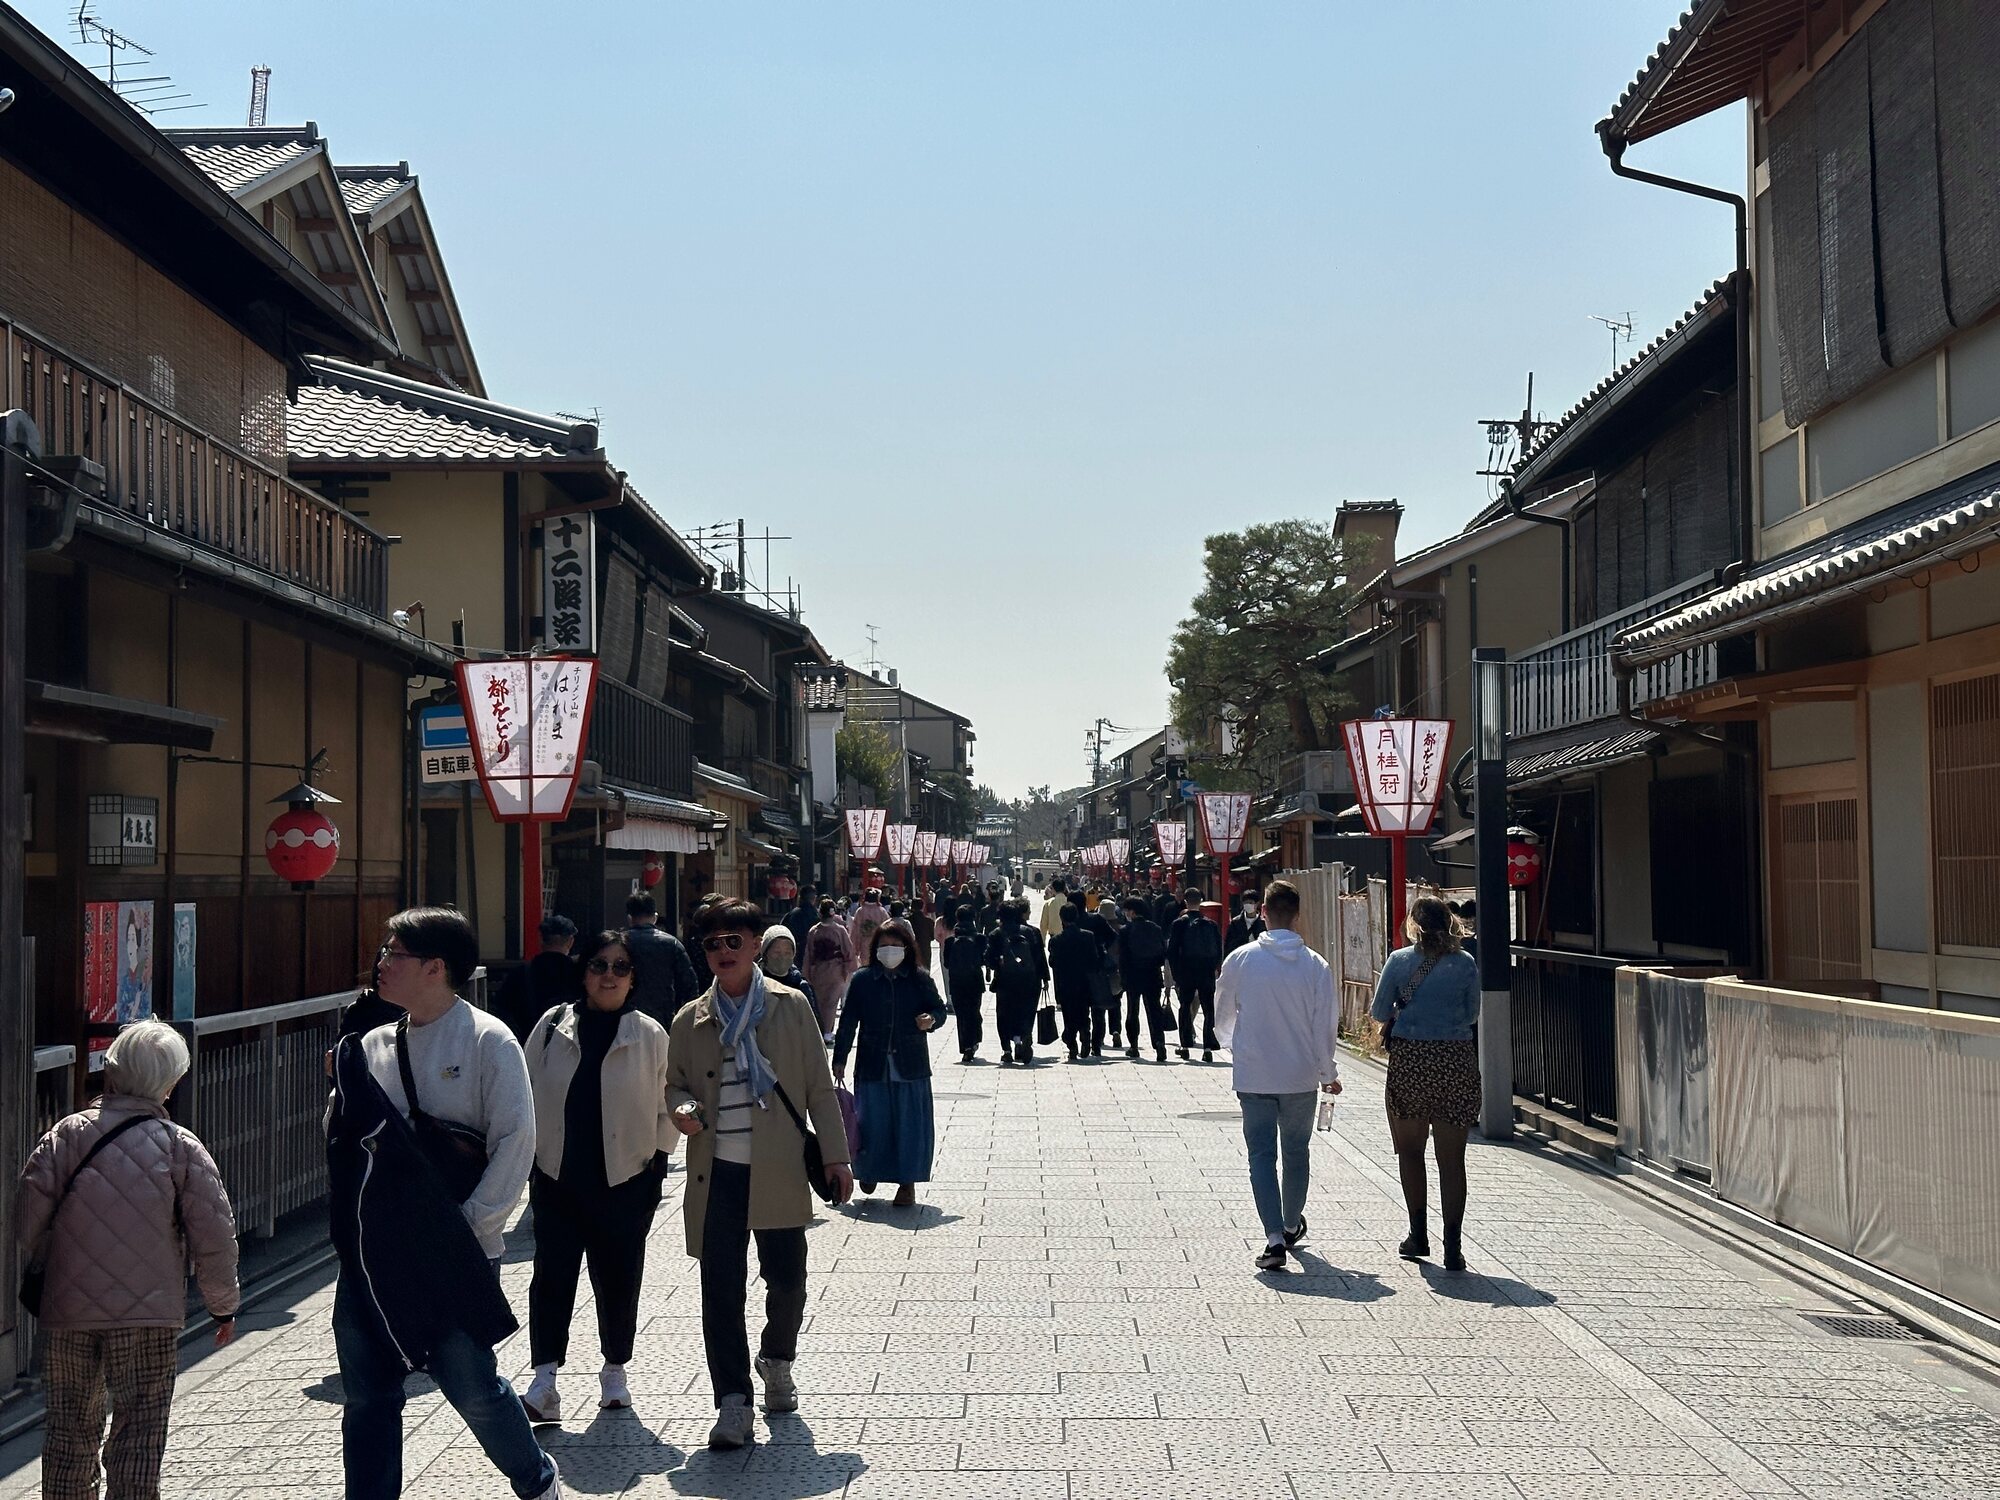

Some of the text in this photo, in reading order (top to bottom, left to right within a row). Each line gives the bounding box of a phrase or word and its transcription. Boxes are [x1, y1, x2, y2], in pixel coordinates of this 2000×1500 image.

[487, 675, 513, 764] 都をどり
[551, 674, 569, 740] はれま
[569, 666, 582, 719] チリメン山椒
[1377, 728, 1400, 795] 月桂冠
[1419, 729, 1437, 793] 都をどり
